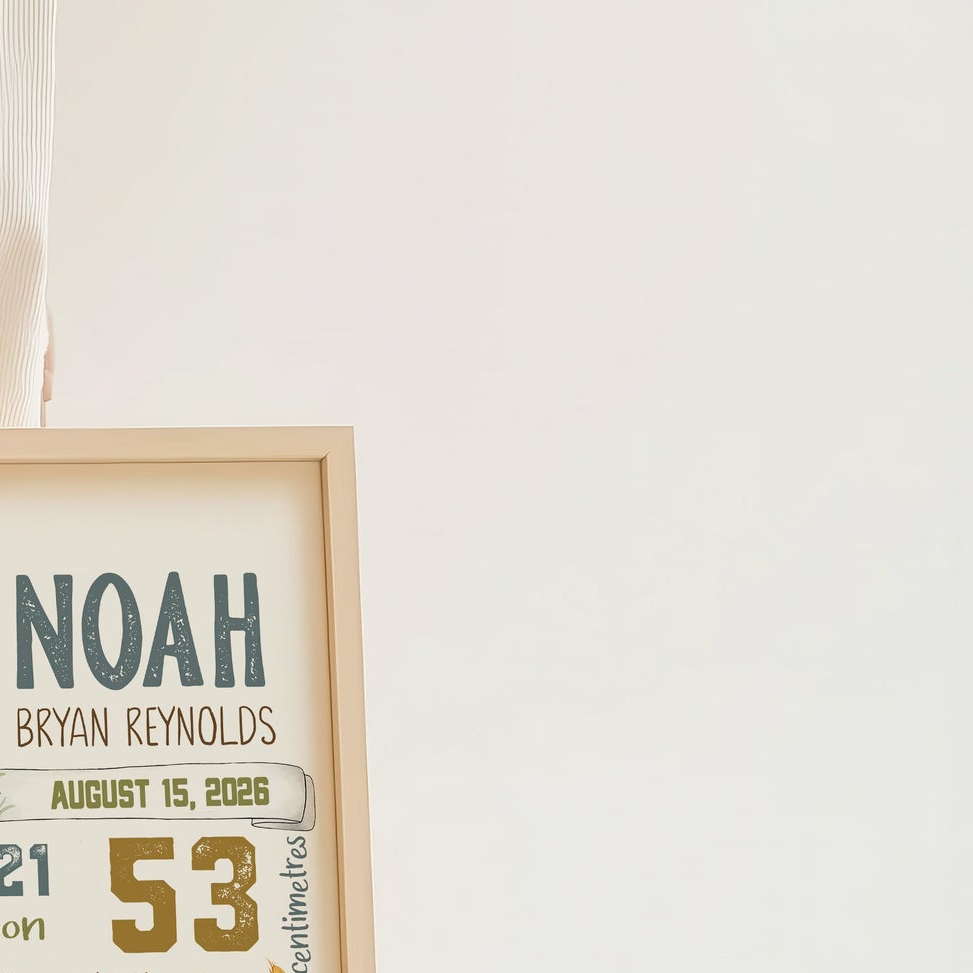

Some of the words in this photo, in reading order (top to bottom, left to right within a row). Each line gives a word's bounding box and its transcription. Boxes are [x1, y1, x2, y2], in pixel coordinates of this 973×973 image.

[15, 571, 266, 691] NOAH
[16, 706, 109, 748] BRYAN
[126, 705, 277, 747] REYNOLDS
[50, 778, 150, 810] AUGUST
[161, 777, 196, 811] 15,
[204, 776, 270, 807] 2026
[108, 835, 260, 954] 53
